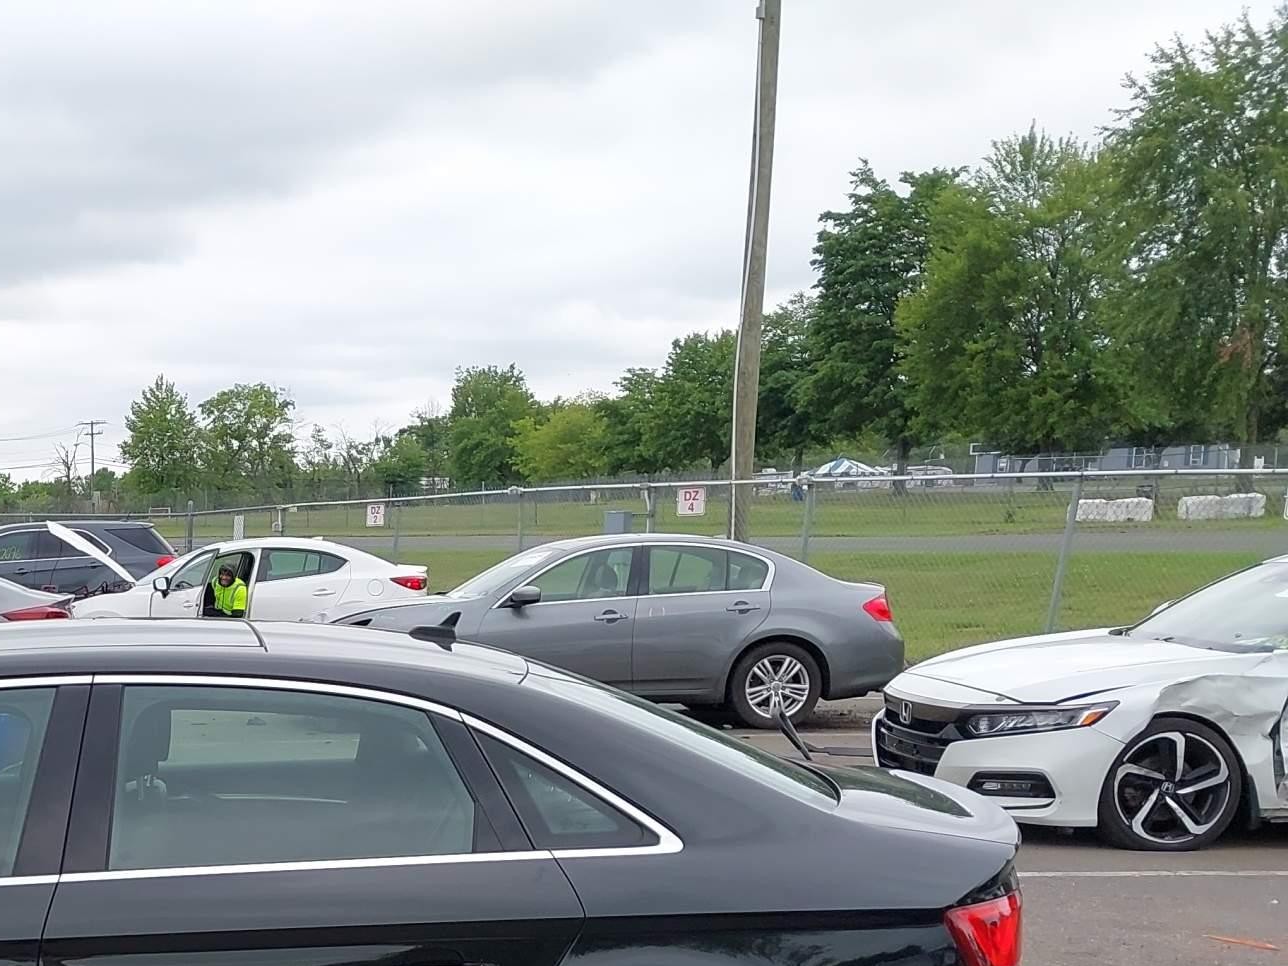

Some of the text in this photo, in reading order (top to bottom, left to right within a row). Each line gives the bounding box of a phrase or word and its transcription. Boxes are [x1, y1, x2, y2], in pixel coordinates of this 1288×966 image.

[683, 490, 700, 502] DZ
[370, 505, 381, 515] DZ
[687, 501, 695, 513] 4
[373, 515, 378, 524] 2
